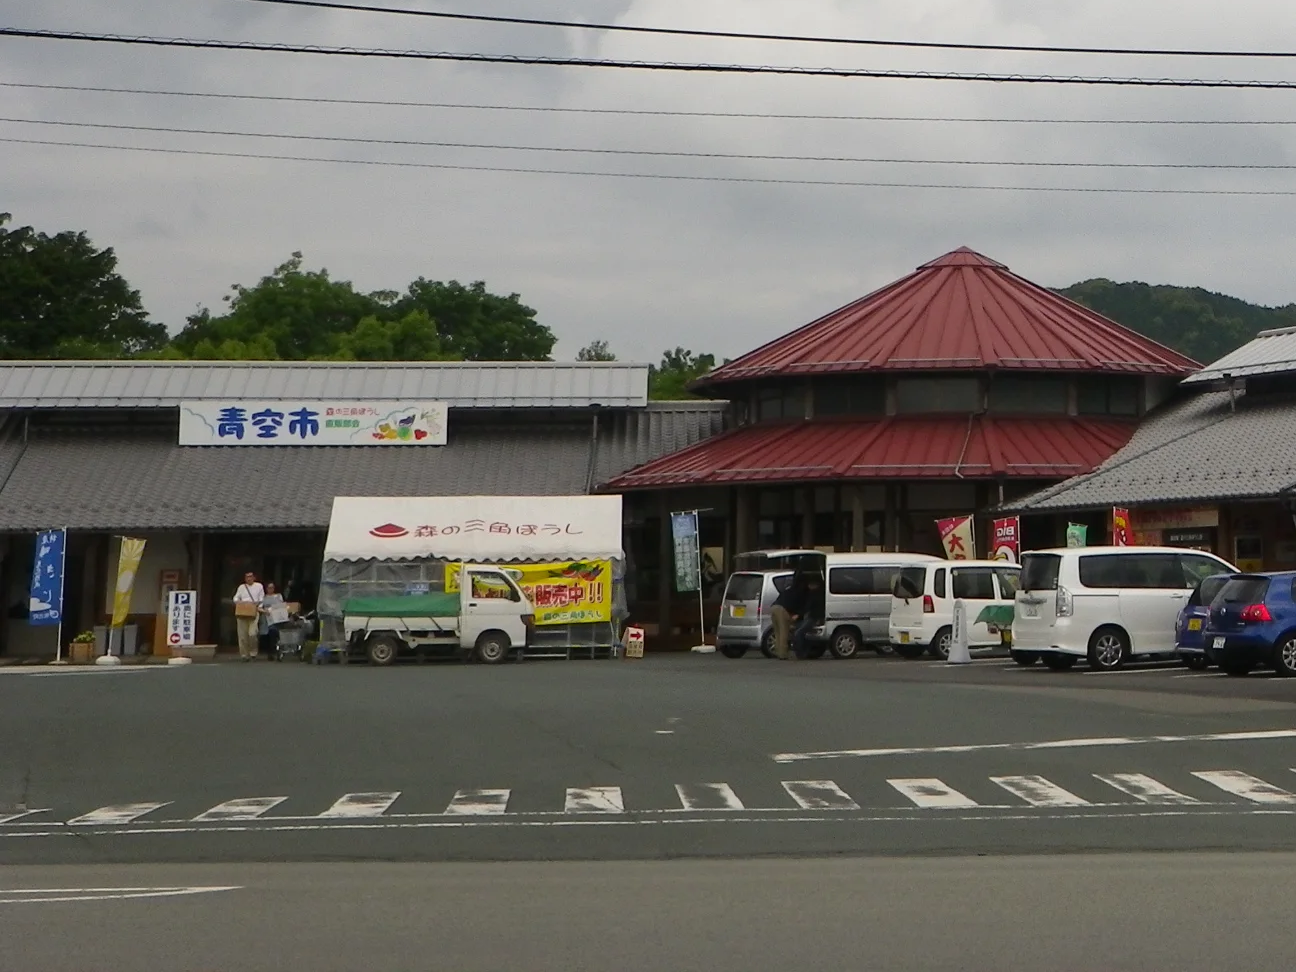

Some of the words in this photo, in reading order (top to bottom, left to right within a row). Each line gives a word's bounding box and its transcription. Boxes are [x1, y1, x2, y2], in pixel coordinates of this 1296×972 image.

[217, 406, 320, 440] 青空市
[413, 519, 584, 537] 森の三角ぼうし
